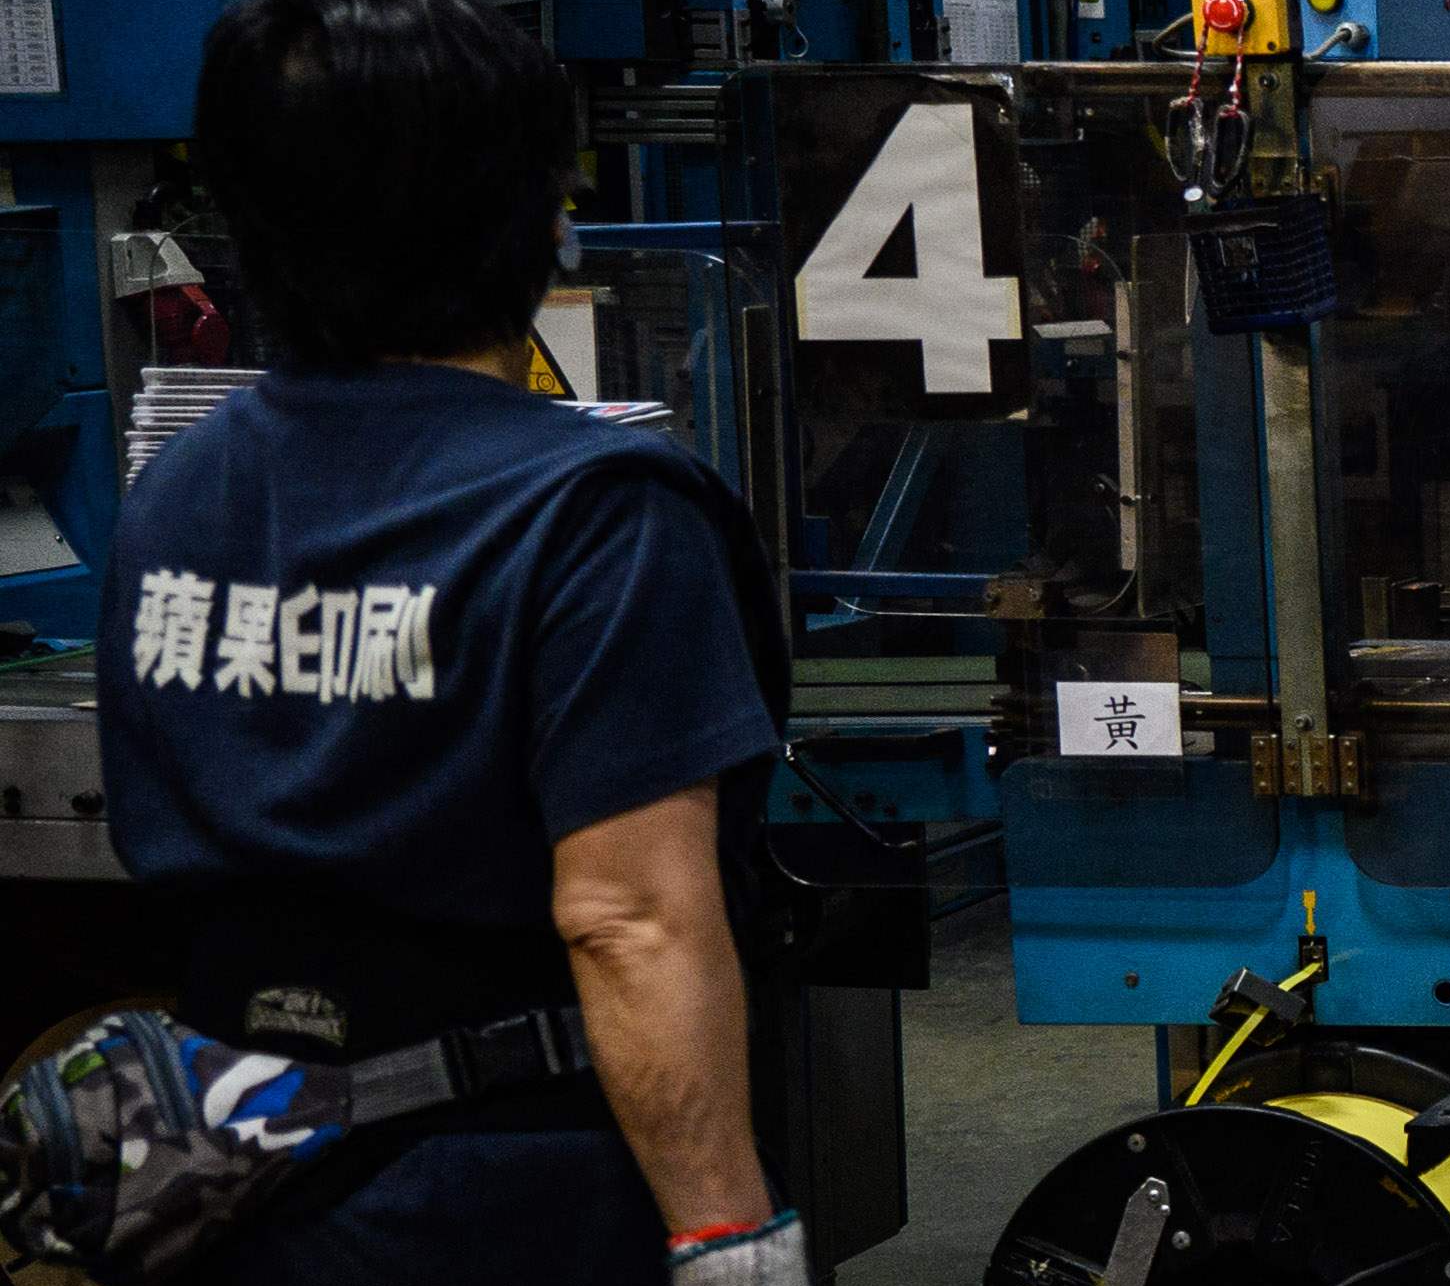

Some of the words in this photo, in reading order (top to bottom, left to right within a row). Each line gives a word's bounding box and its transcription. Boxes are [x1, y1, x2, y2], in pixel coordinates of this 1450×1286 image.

[795, 103, 1023, 393] 4
[132, 568, 438, 705] 蘋果印刷
[1093, 694, 1146, 751] 黃
